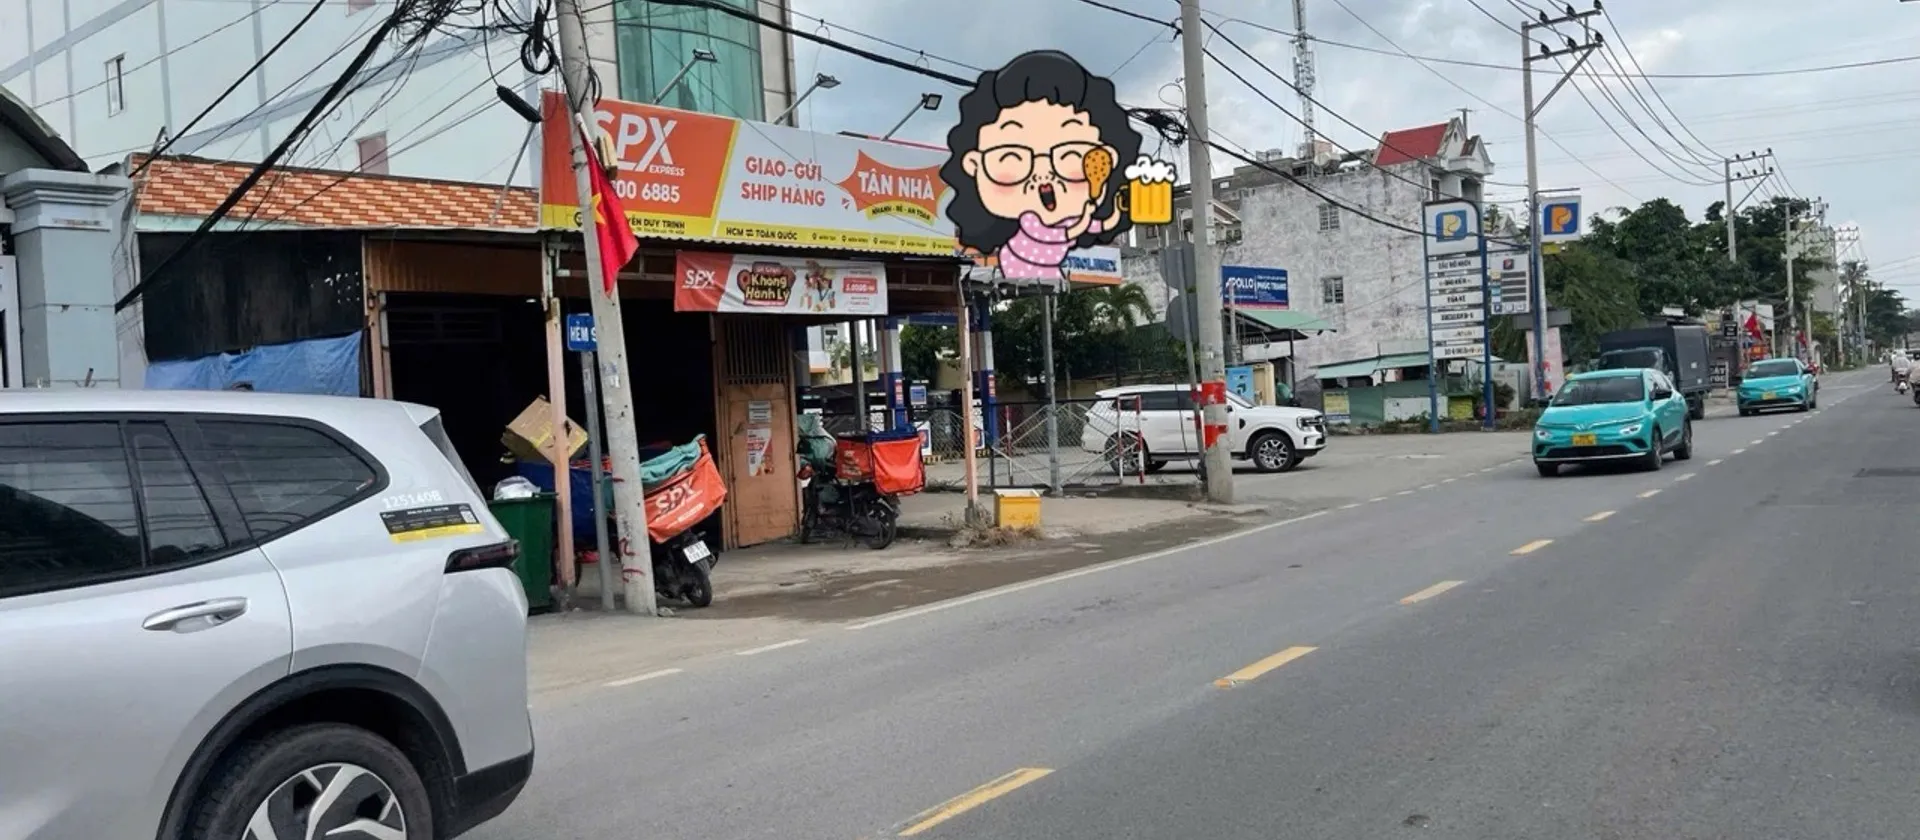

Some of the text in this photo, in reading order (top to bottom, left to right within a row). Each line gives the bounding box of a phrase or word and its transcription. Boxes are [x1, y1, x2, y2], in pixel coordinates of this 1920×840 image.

[650, 164, 685, 177] EXPRESS
[745, 155, 822, 181] GIAO-GỬI
[642, 184, 680, 203] 6885
[858, 168, 935, 200] TẬN NHÀ
[741, 182, 825, 207] SHIP HÀNG
[644, 218, 661, 228] DUY
[726, 227, 744, 236] HCM
[684, 269, 716, 288] SPX
[570, 320, 589, 342] HẺM
